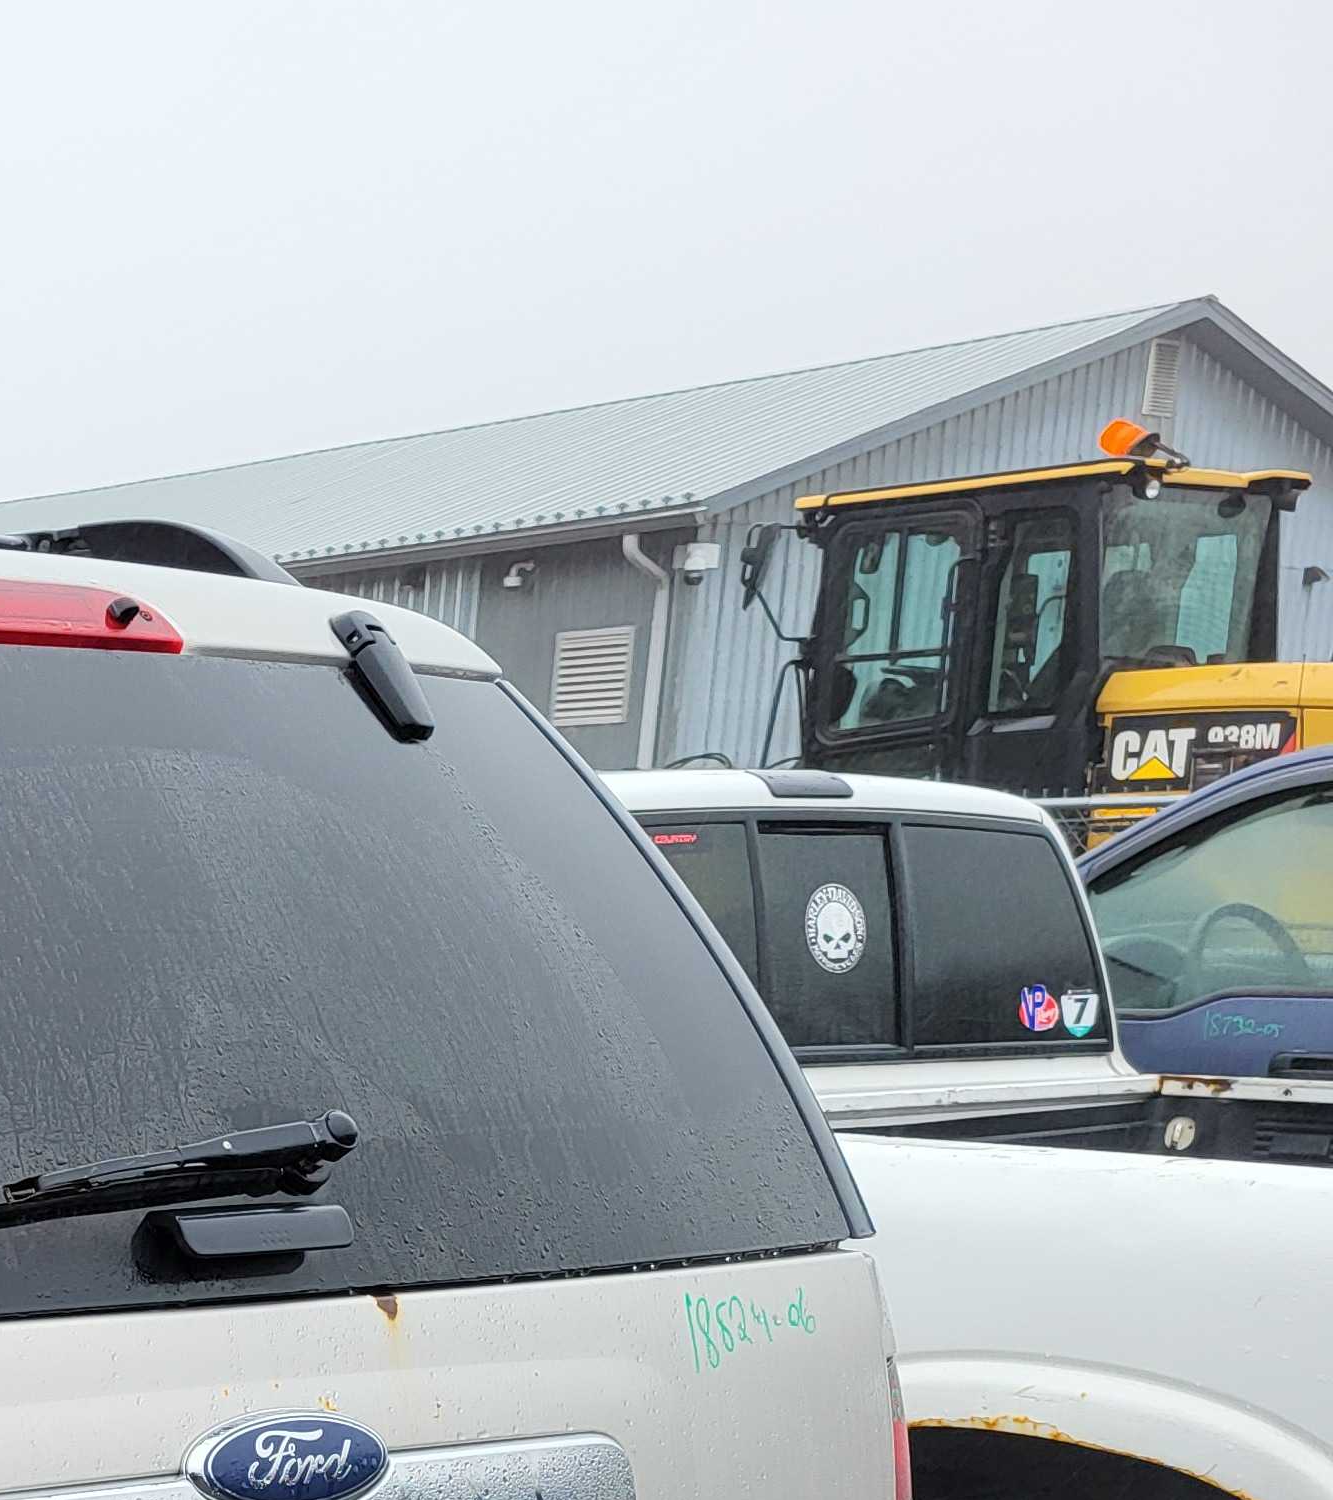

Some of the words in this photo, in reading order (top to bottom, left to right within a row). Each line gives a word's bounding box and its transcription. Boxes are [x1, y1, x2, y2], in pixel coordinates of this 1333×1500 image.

[1110, 728, 1196, 780] CAT
[1074, 998, 1090, 1025] 7
[685, 1286, 817, 1374] 18824-06
[247, 1428, 353, 1490] Ford
